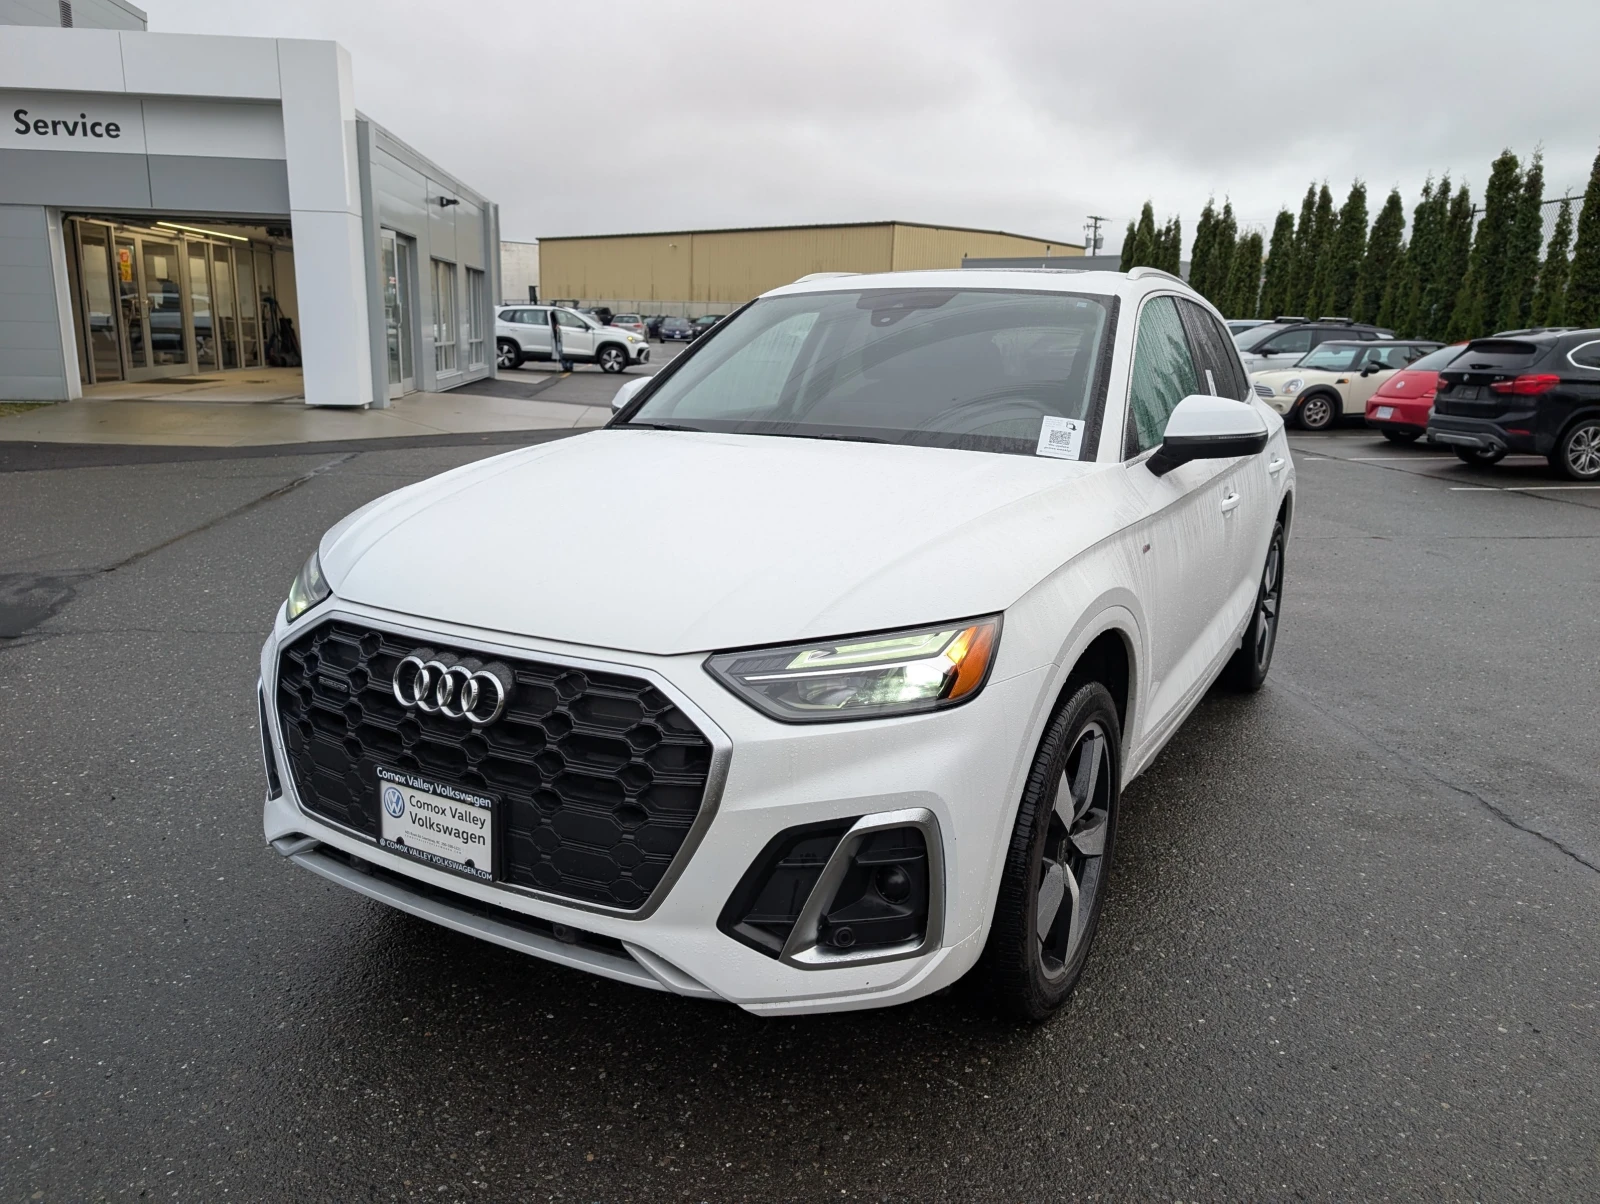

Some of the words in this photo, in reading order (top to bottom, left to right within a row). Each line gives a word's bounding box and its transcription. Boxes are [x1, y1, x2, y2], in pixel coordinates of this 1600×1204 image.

[13, 109, 121, 139] Service
[376, 766, 407, 785] Comox
[407, 774, 434, 794] Valley
[434, 782, 492, 808] Volkswagen
[409, 795, 447, 817] Comox
[449, 806, 486, 830] Valley
[409, 811, 486, 846] Volkswagen
[386, 840, 408, 853] COMOX
[408, 847, 432, 861] VALLEY
